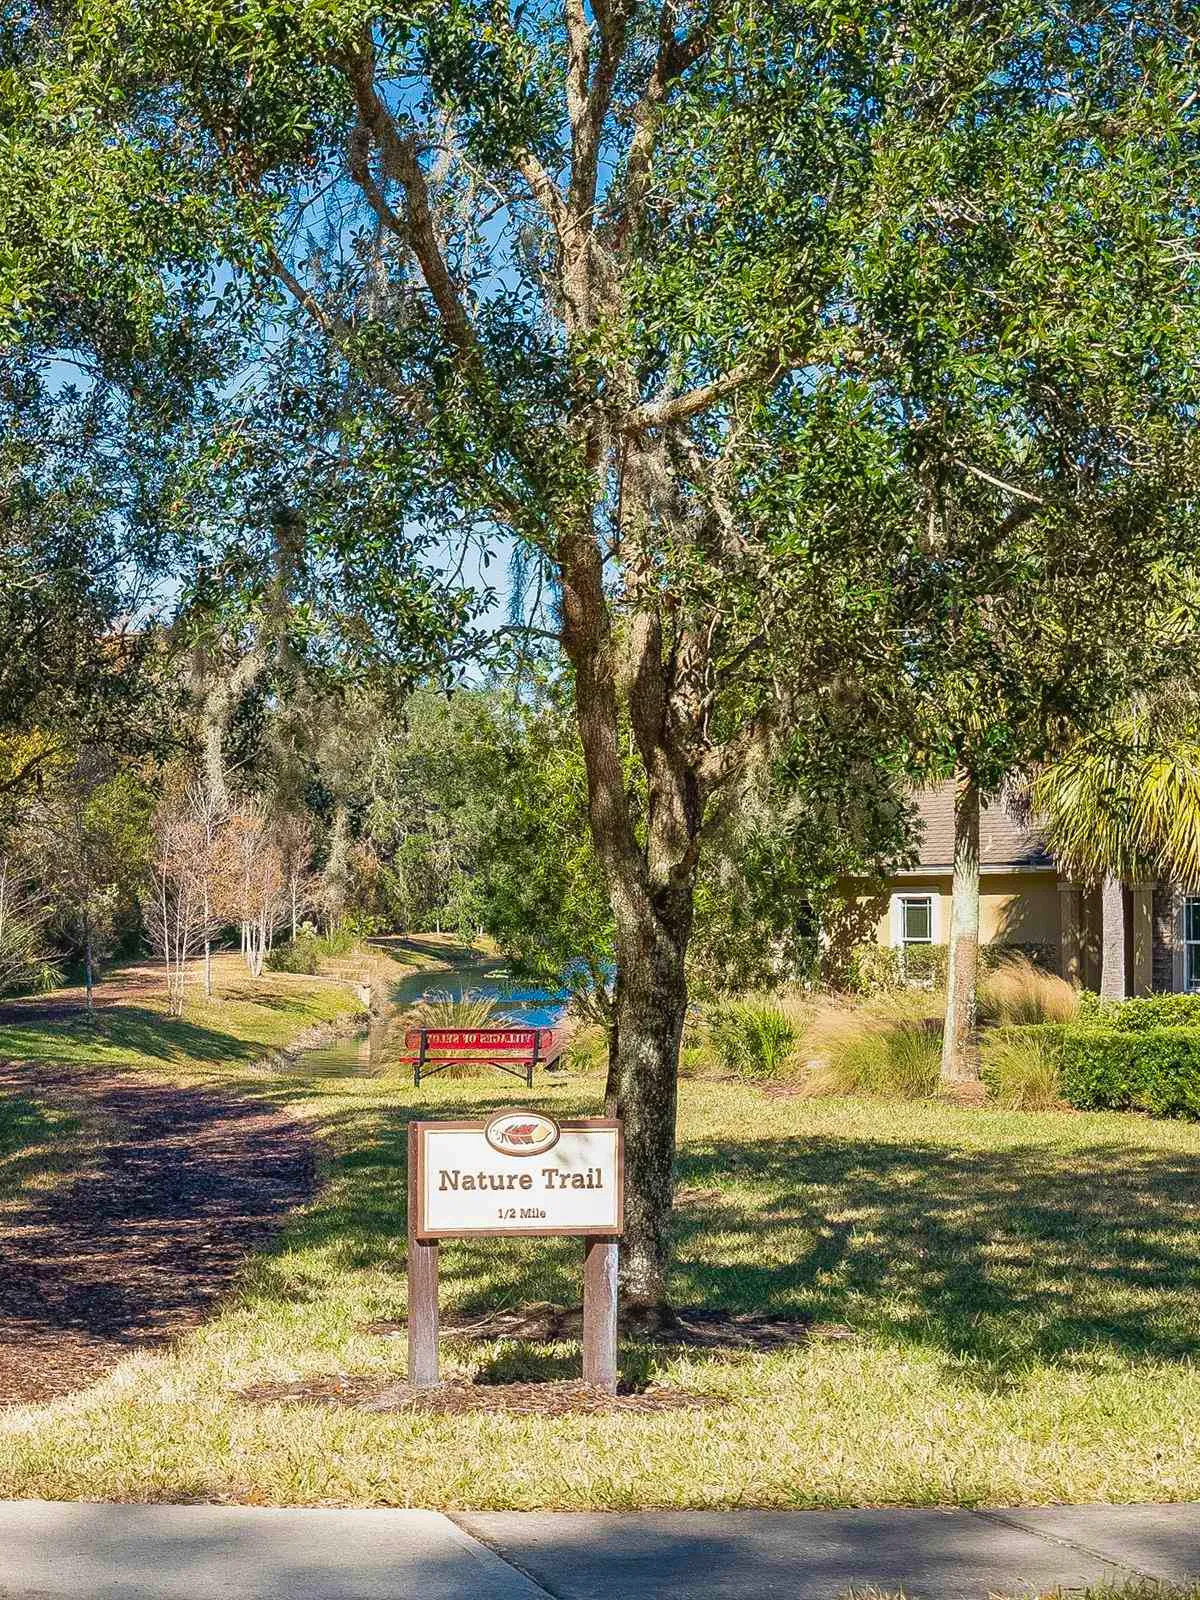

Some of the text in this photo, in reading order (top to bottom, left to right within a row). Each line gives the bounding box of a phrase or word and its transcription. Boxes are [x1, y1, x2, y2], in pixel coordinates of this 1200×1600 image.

[438, 1167, 604, 1191] Nature Trail
[498, 1208, 547, 1219] 1/2 Mile
